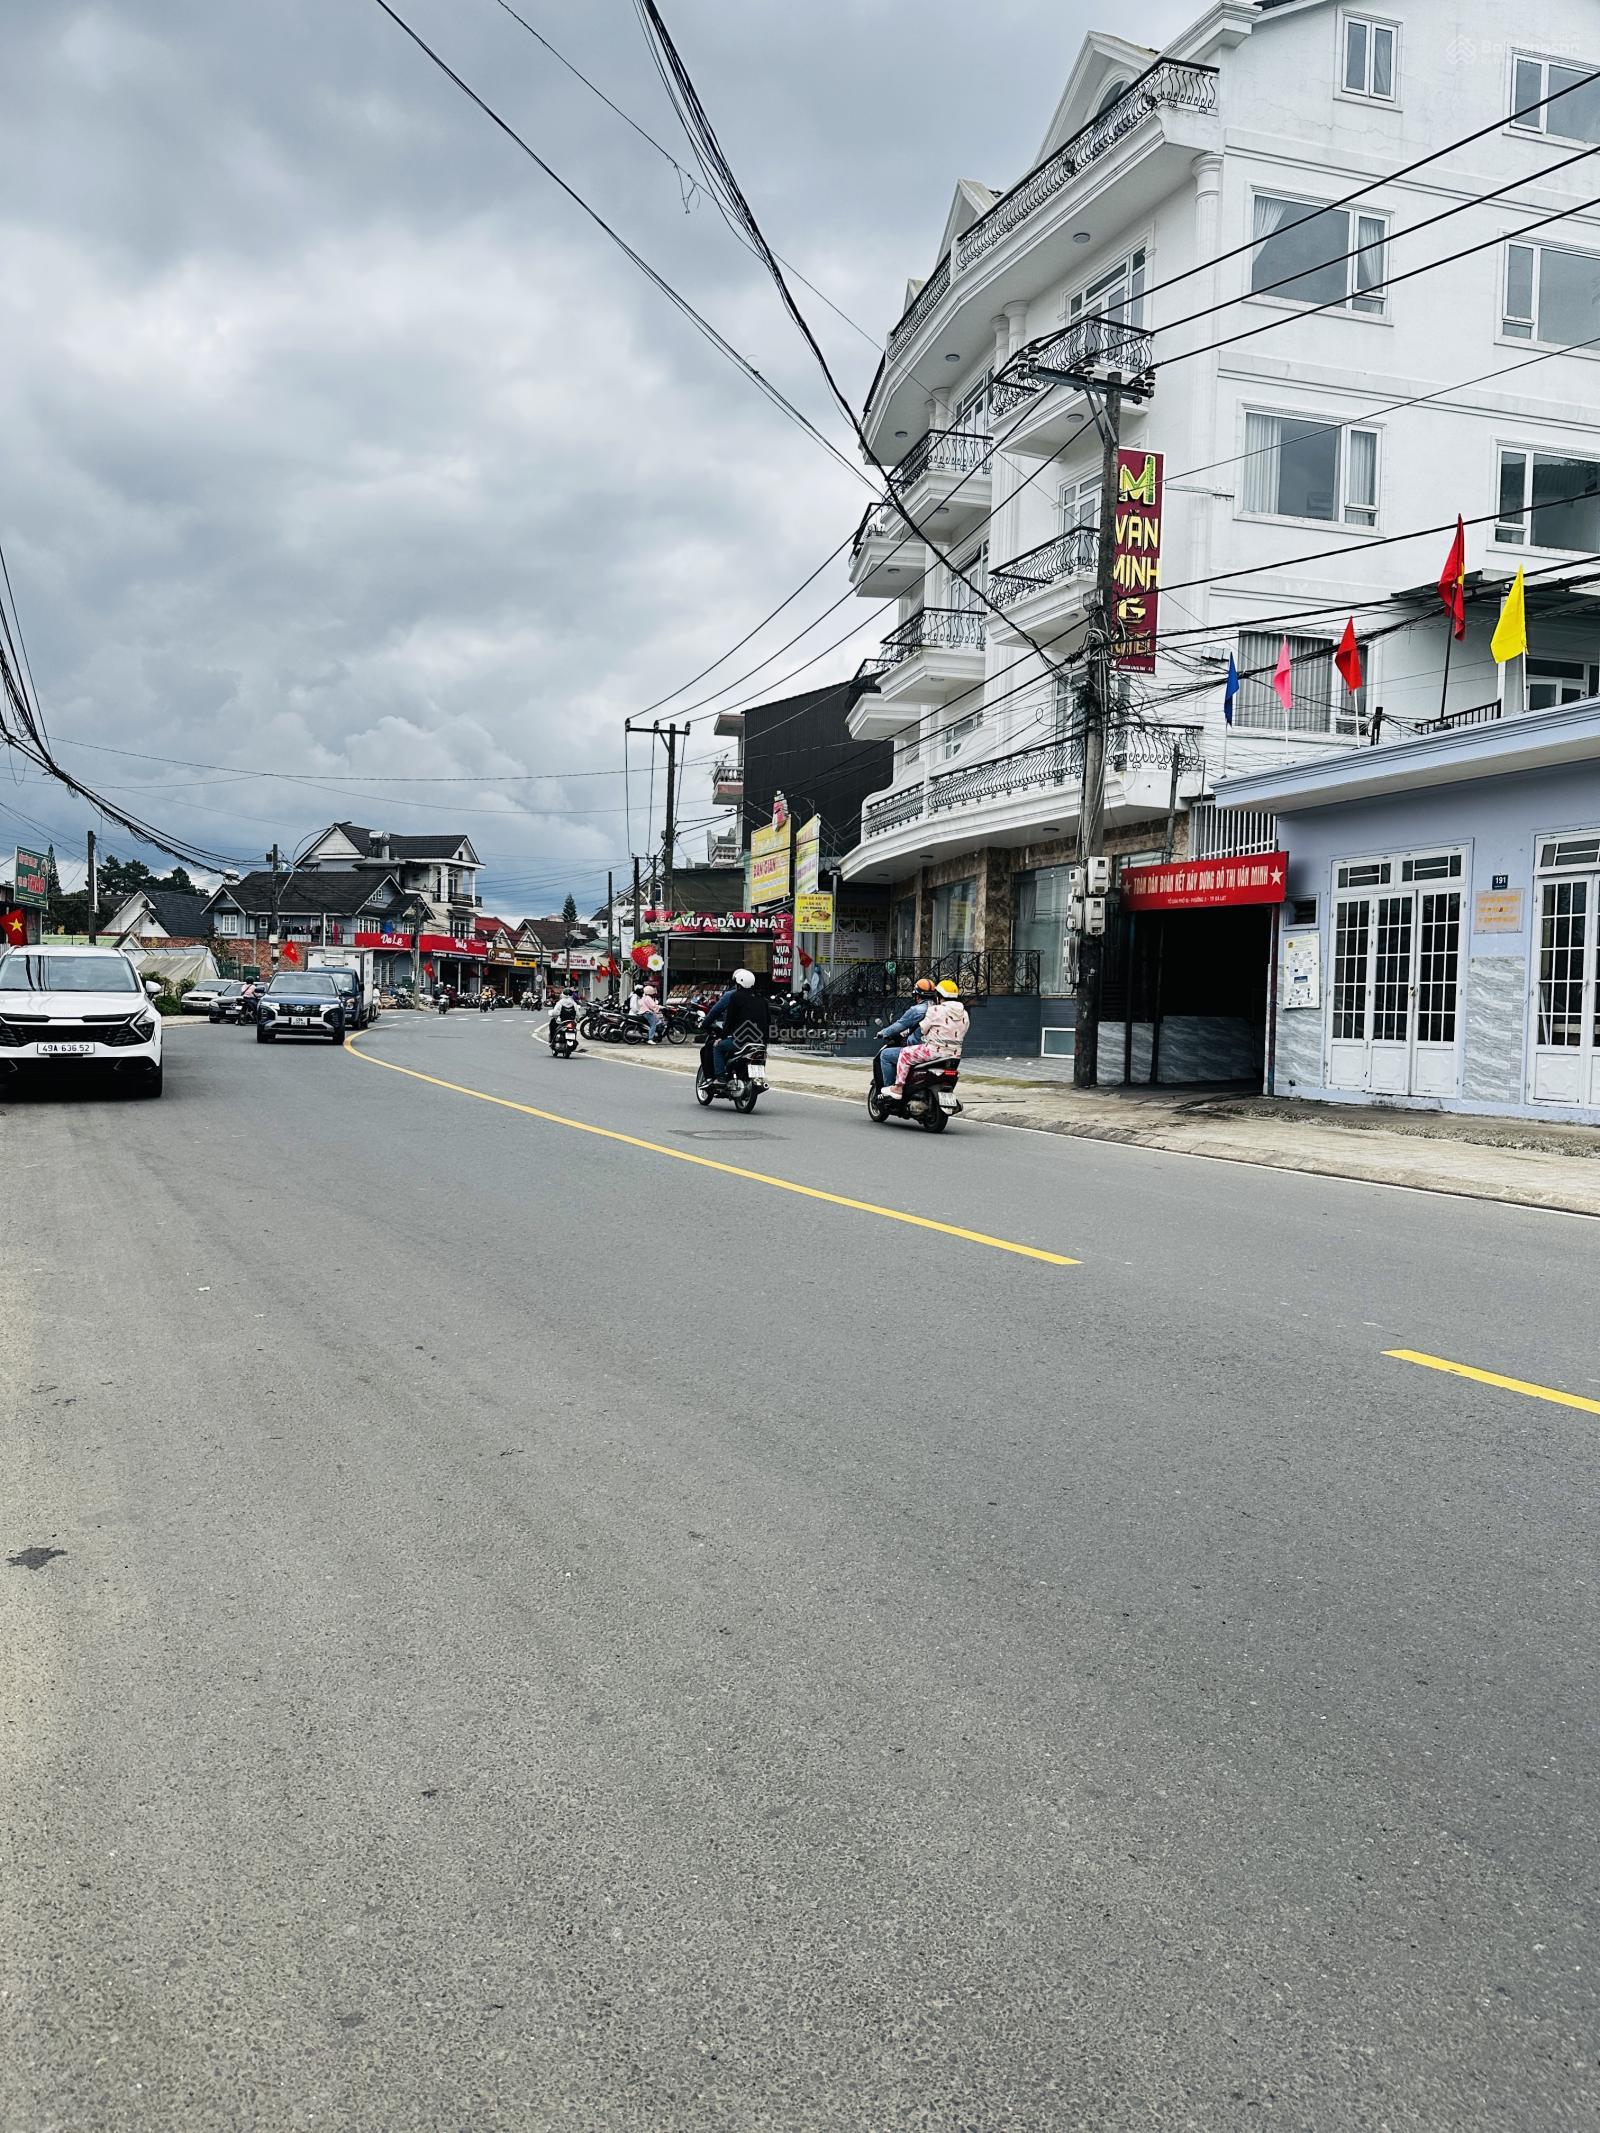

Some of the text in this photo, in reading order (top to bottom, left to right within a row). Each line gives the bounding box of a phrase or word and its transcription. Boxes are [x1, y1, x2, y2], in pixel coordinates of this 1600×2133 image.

[1119, 455, 1156, 505] M
[1115, 509, 1158, 549] VĂN
[1175, 869, 1185, 891] KẾT
[1251, 865, 1268, 886] MINH
[1496, 876, 1506, 884] 191
[682, 916, 714, 930] VỰA
[717, 914, 746, 928] DÂU
[750, 914, 787, 930] NHẬT
[776, 945, 790, 955] VỰA
[773, 966, 791, 978] NHẬT
